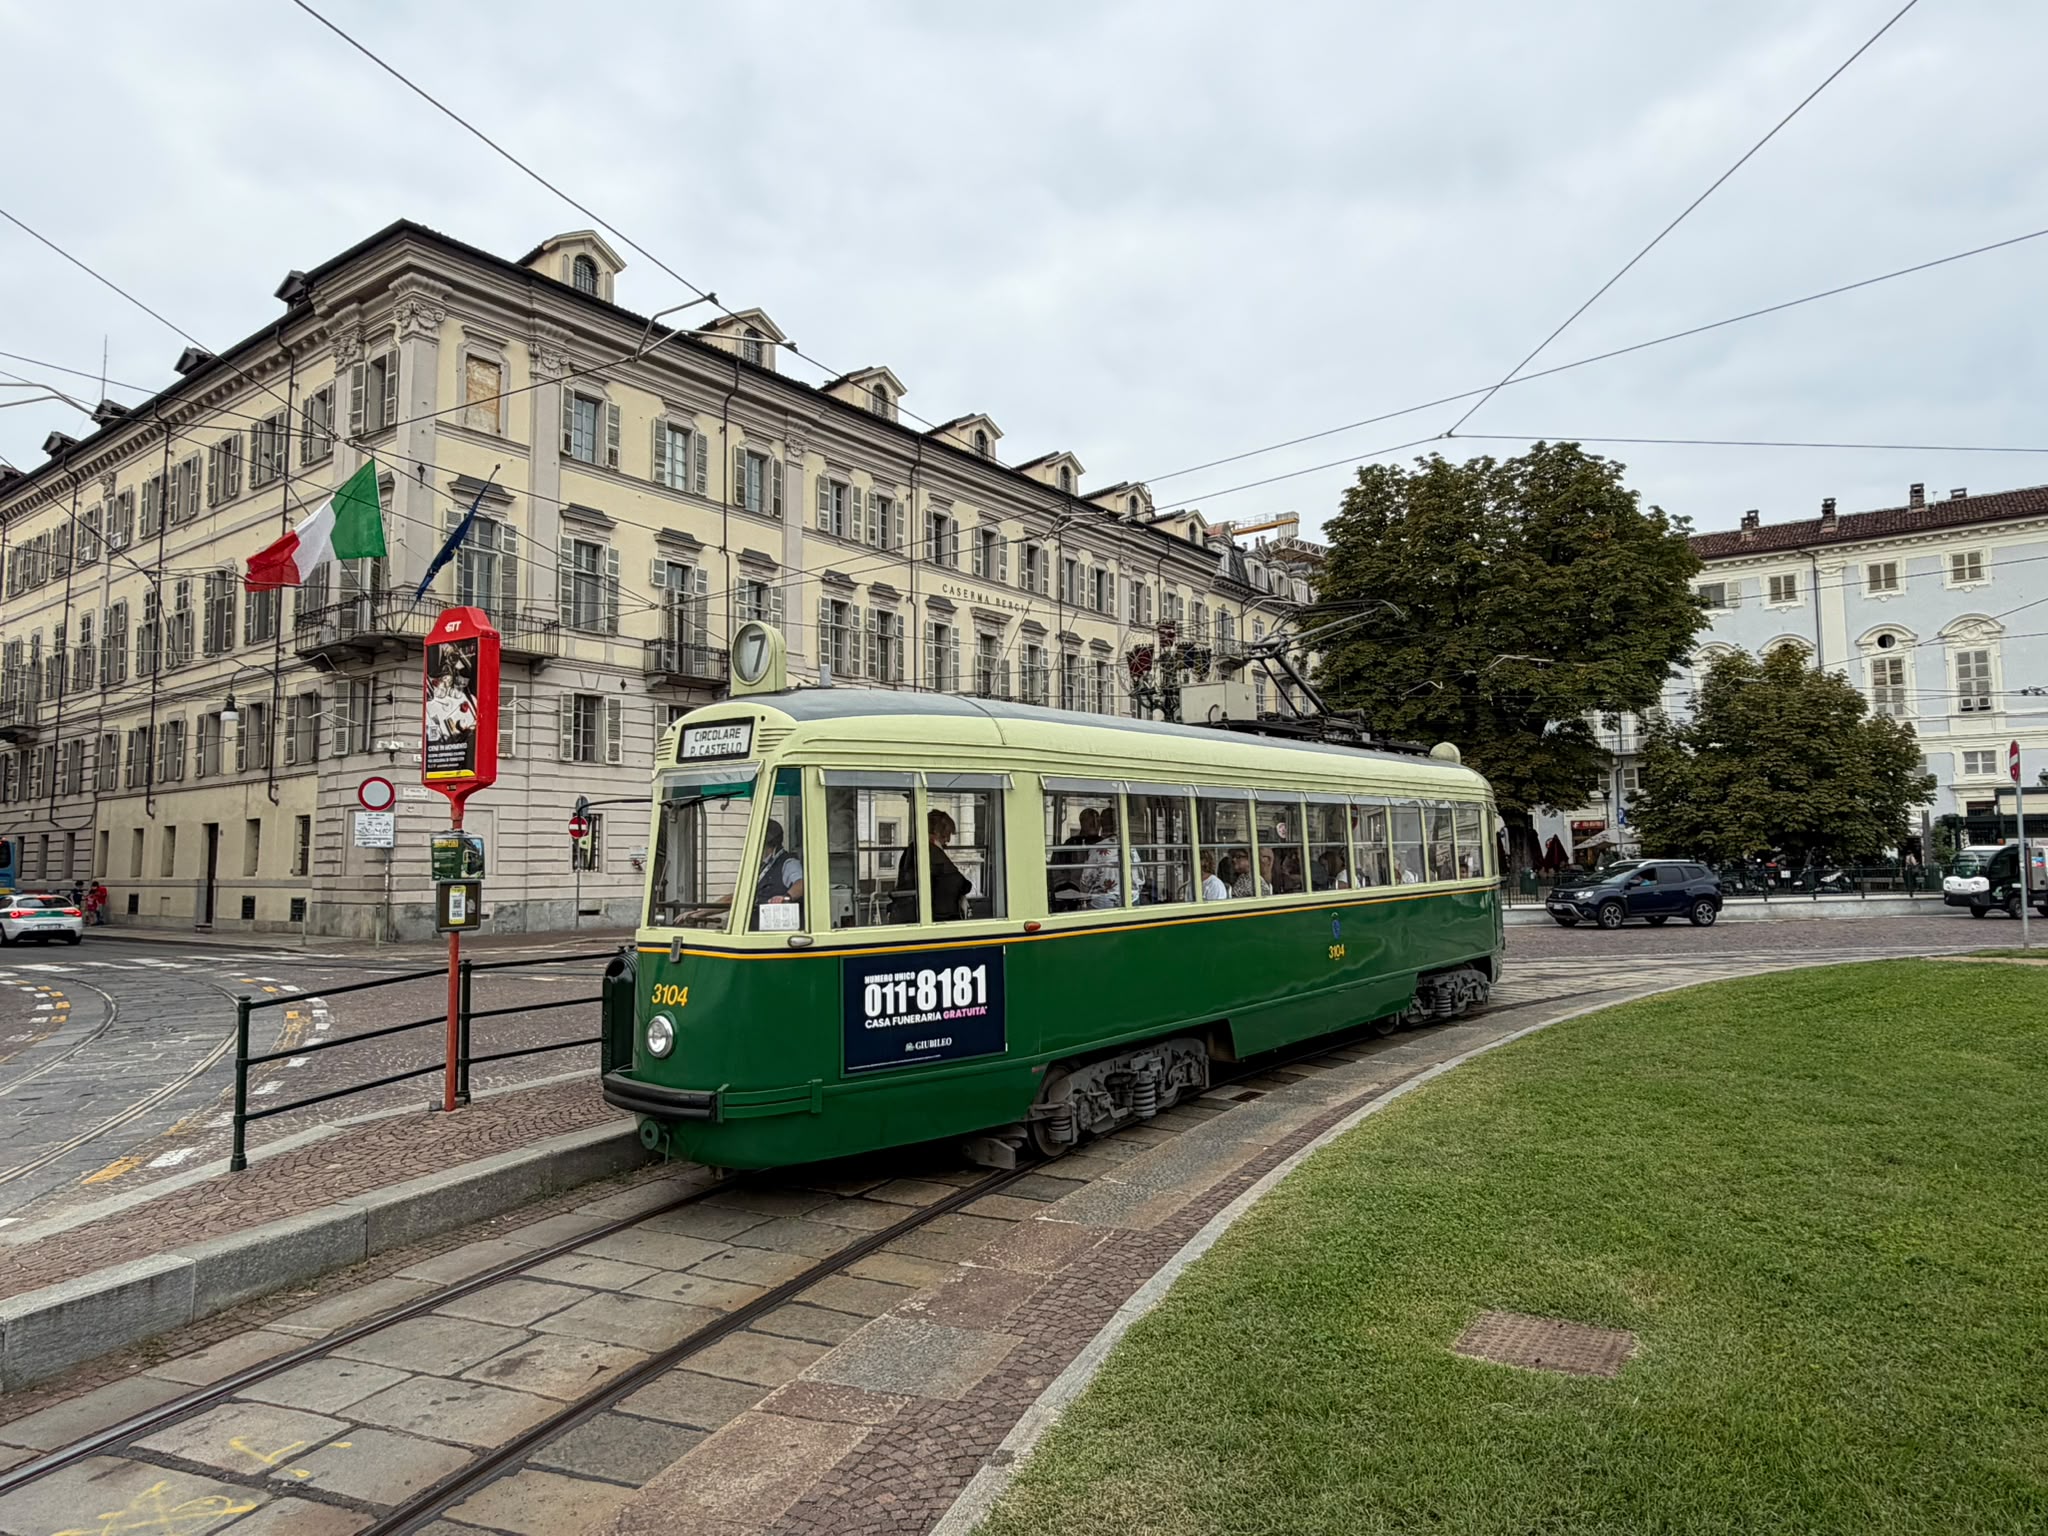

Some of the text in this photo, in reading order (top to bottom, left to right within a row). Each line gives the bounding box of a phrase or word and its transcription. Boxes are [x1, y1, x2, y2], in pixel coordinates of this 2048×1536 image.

[942, 583, 991, 605] CASERMA
[444, 620, 462, 633] GTT
[748, 633, 766, 673] 7
[694, 727, 742, 743] CIRCOLARE
[690, 742, 742, 756] P. CASTELLO
[1328, 943, 1345, 959] 3104
[864, 971, 915, 984] NUMERO UNICO
[651, 983, 689, 1007] 3104
[864, 1017, 892, 1029] CASA
[892, 1012, 942, 1026] FUNERARIA
[915, 1037, 953, 1050] GIUBILEO
